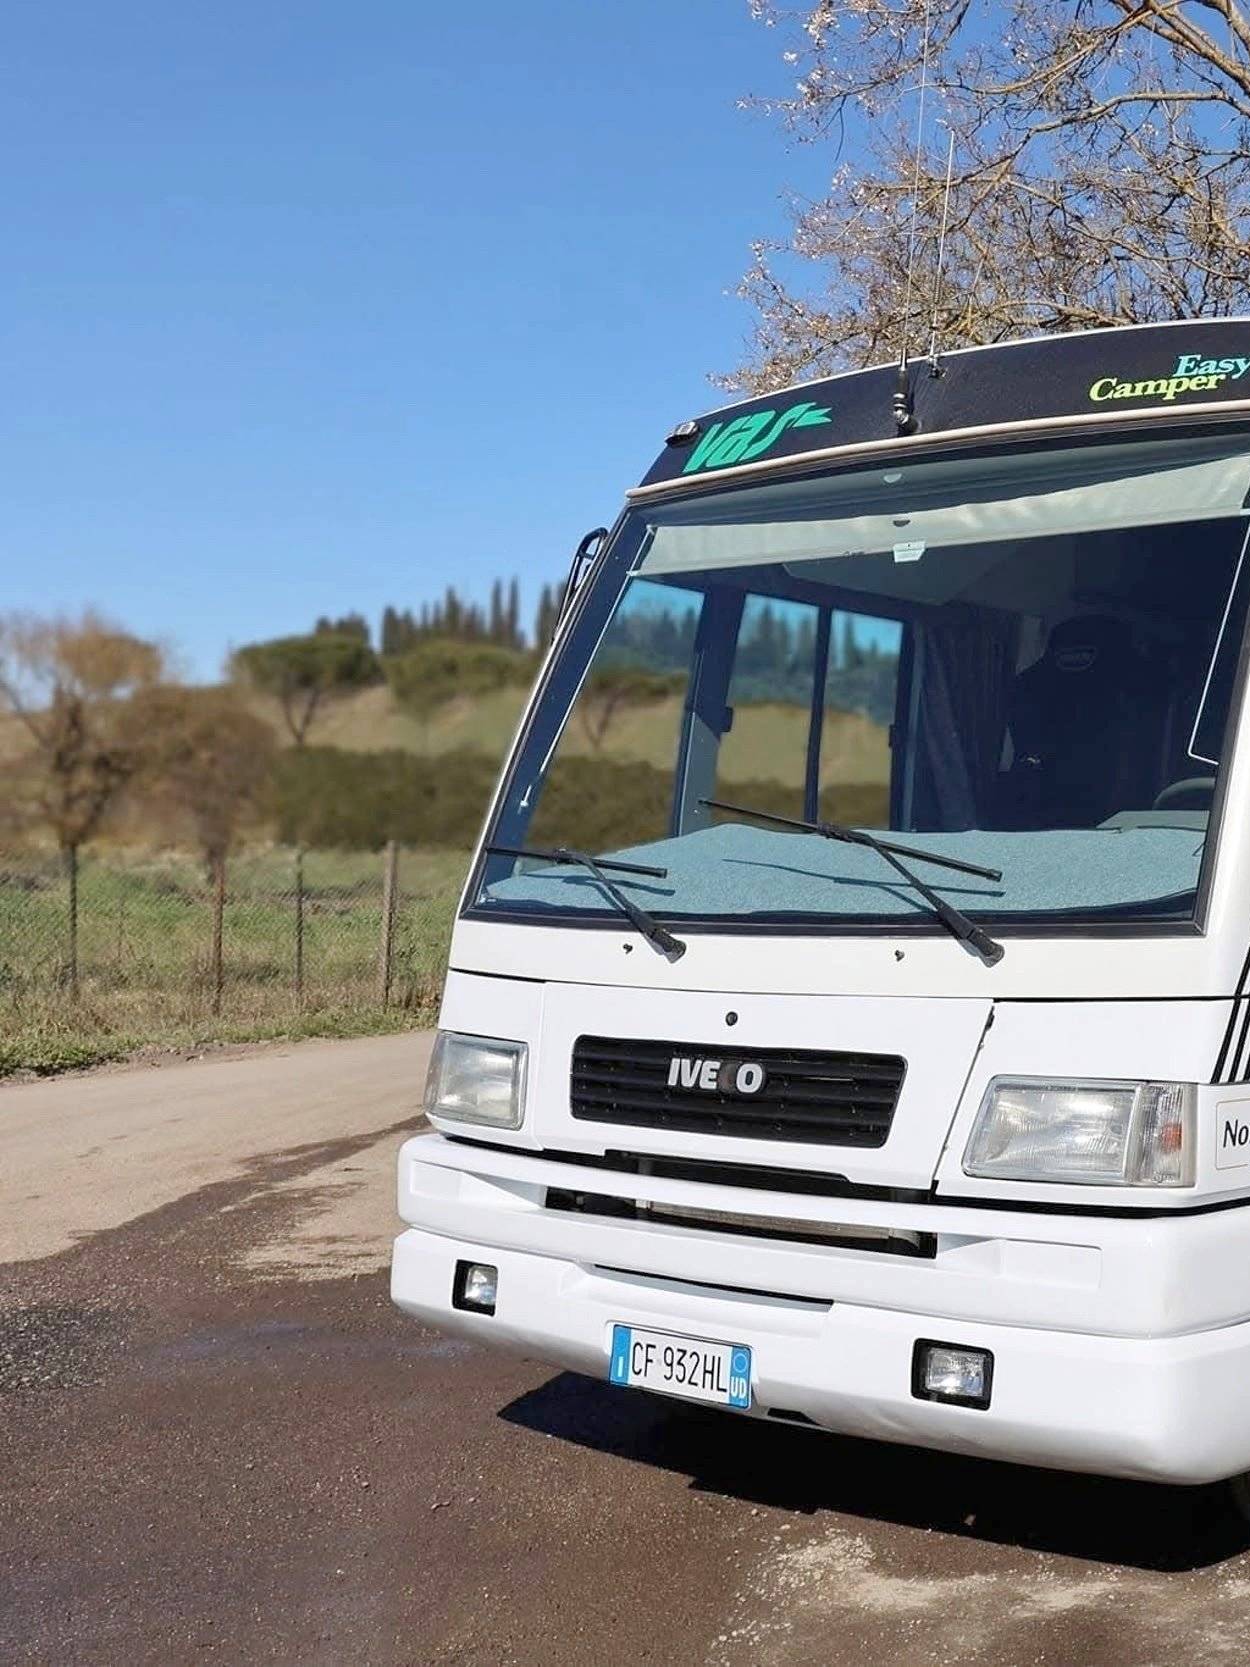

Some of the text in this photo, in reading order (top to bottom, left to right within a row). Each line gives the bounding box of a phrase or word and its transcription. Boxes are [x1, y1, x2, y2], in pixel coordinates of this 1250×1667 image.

[1089, 374, 1226, 401] Camper
[667, 1057, 764, 1094] IVEO
[632, 1342, 728, 1393] CF 932HL
[730, 1376, 748, 1399] UD
